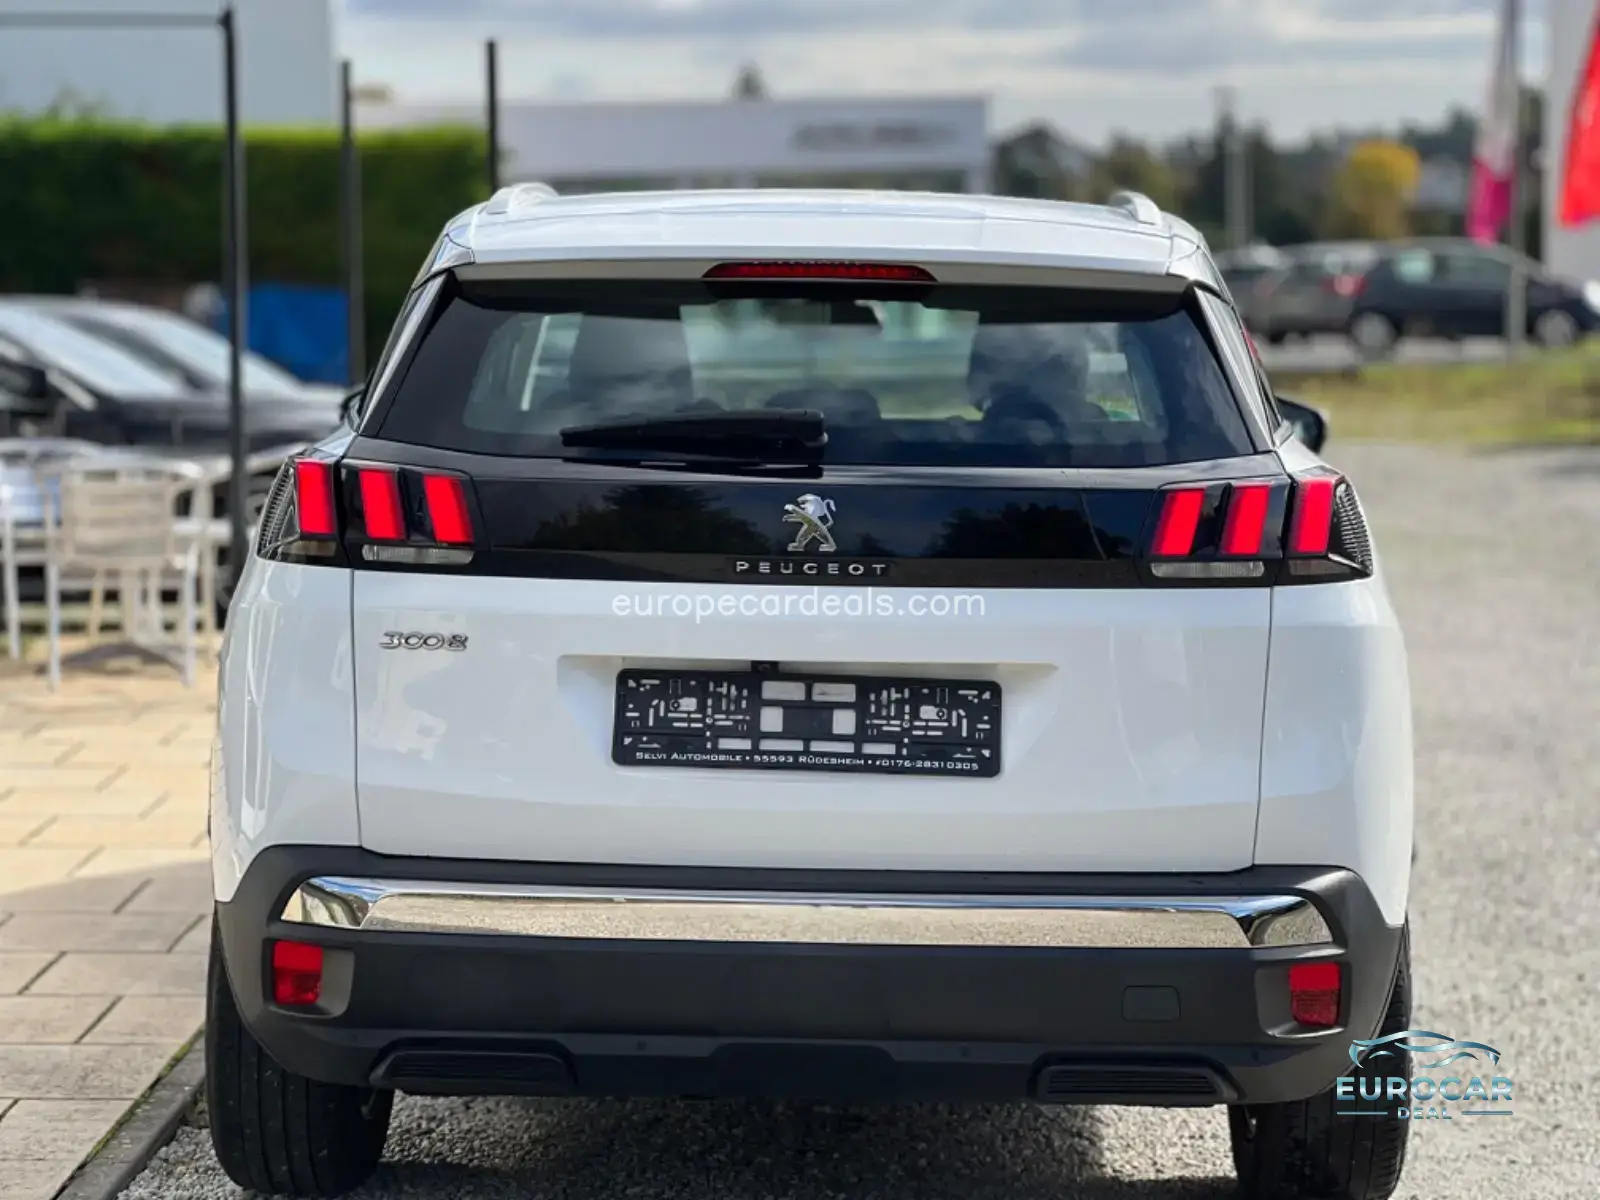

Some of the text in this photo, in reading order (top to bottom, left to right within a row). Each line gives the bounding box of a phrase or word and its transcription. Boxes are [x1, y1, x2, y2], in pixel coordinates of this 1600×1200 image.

[735, 560, 888, 577] PEUGEOT
[378, 630, 469, 652] 3008
[670, 752, 743, 761] AUTOMOBILE
[753, 754, 794, 763] 55593
